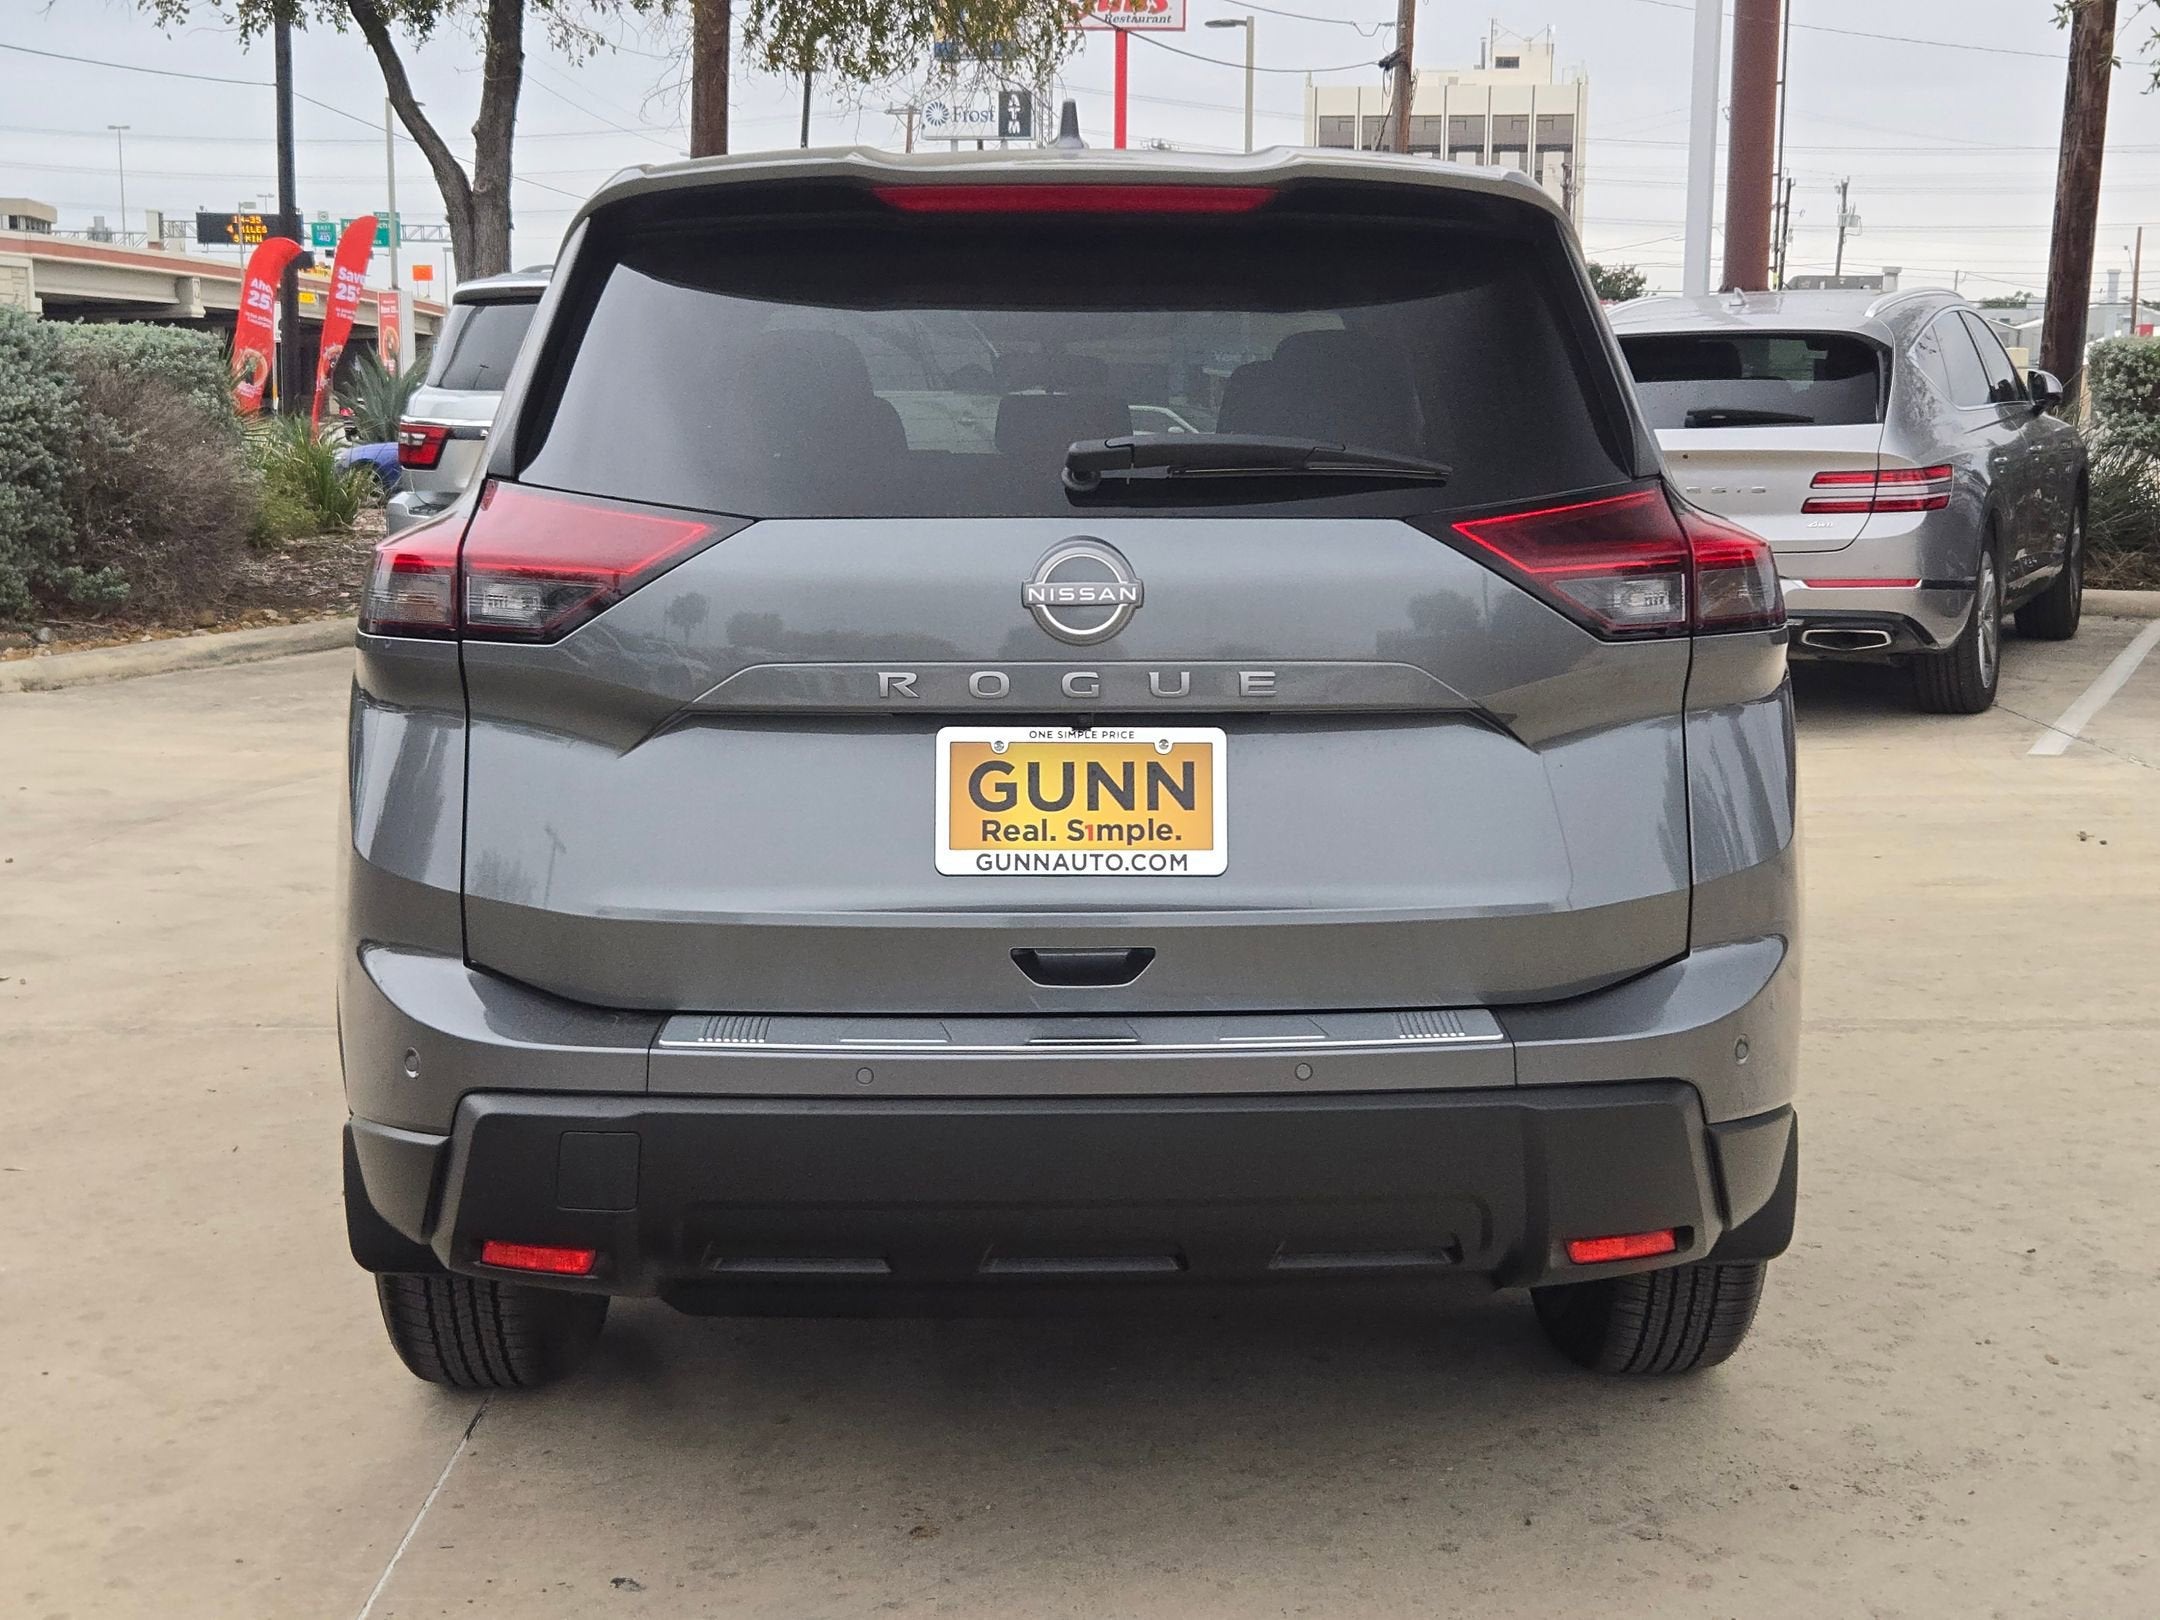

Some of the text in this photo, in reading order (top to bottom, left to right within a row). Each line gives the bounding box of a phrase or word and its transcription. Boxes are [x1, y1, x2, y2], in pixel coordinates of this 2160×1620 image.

[1104, 13, 1173, 25] Restaurant
[951, 104, 996, 123] Frost
[1007, 93, 1021, 134] ATM
[1027, 586, 1138, 602] NISSAN
[877, 670, 1278, 699] ROGUE
[1029, 730, 1136, 740] ONE SIMPLE PRICE
[967, 760, 1196, 813] GUNN
[981, 818, 1057, 842] Real.
[975, 852, 1189, 872] GUNNAUTO.COM
